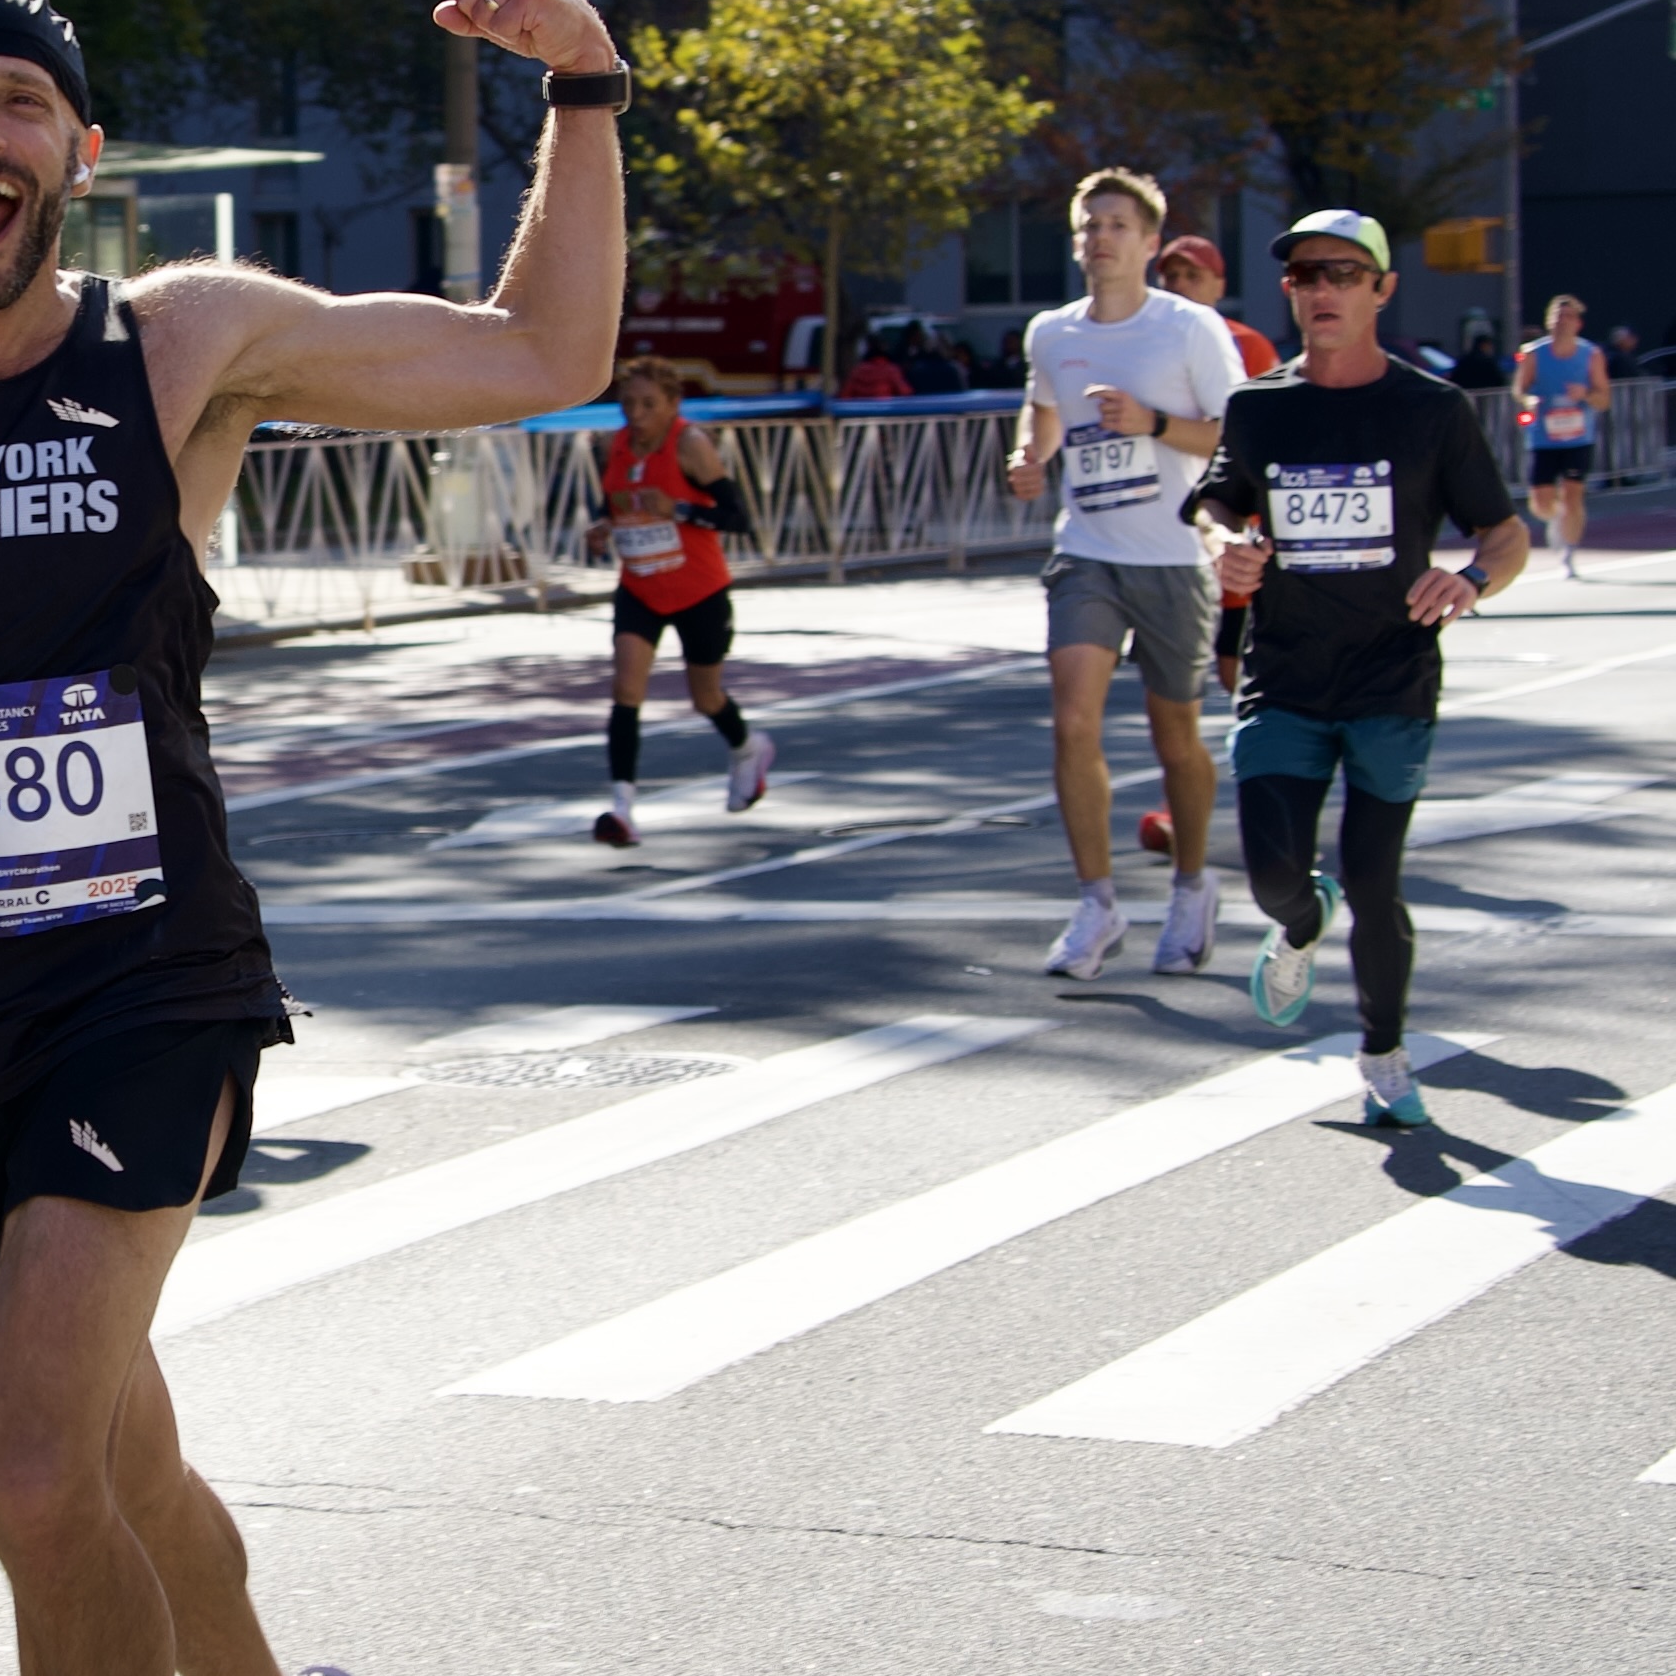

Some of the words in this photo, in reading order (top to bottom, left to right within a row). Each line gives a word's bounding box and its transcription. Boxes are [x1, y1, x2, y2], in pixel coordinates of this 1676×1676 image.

[1079, 441, 1137, 474] 6797
[1286, 492, 1371, 525] 8473
[59, 707, 106, 726] TATA
[87, 875, 138, 897] 2025
[35, 890, 50, 905] C
